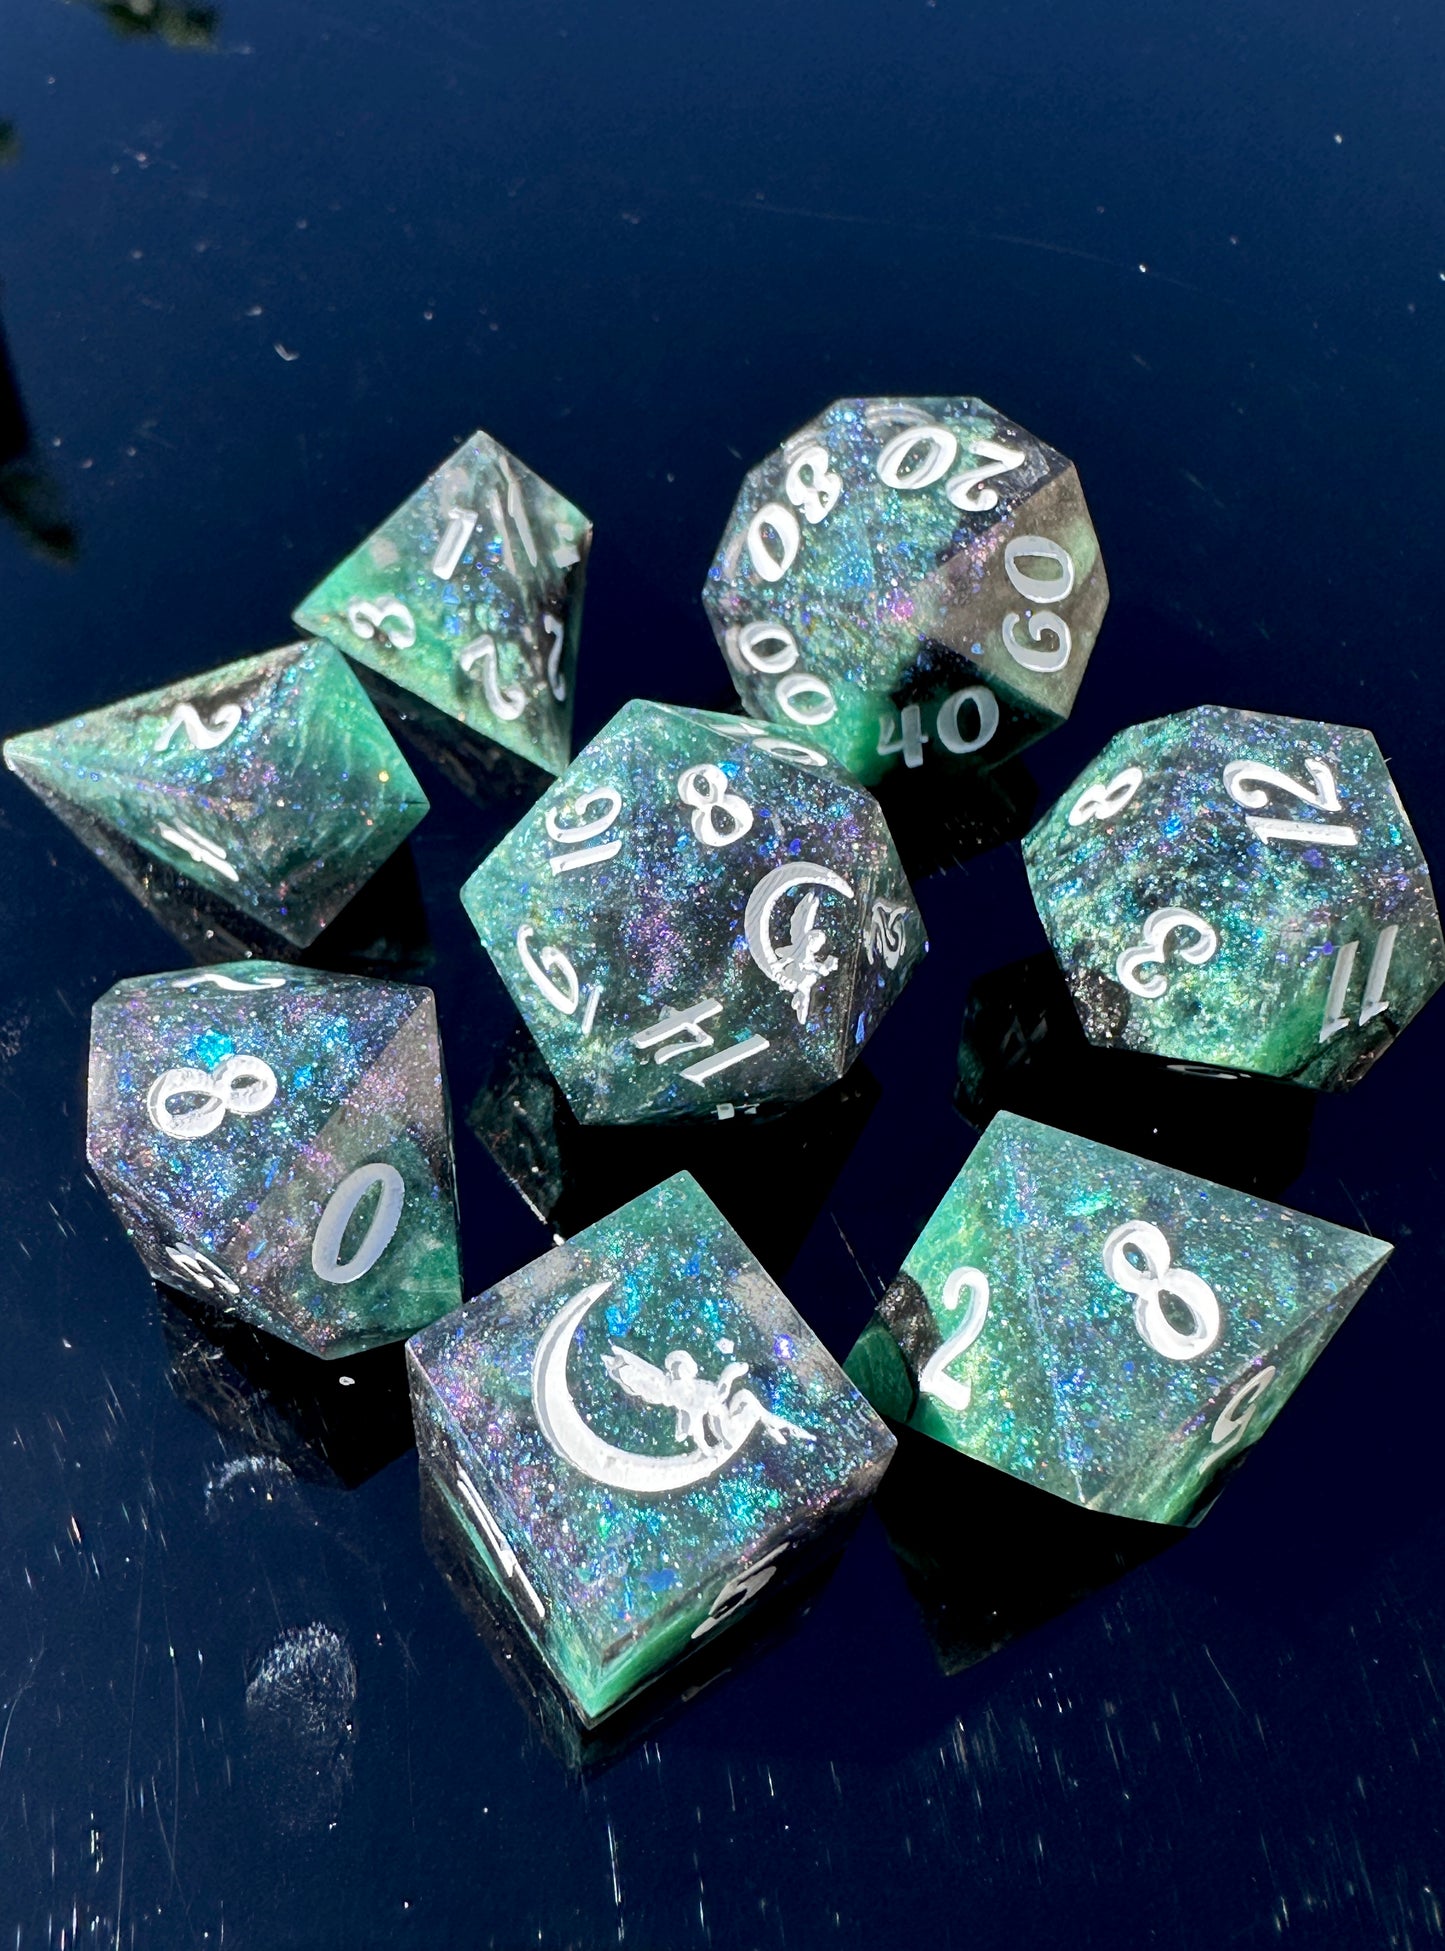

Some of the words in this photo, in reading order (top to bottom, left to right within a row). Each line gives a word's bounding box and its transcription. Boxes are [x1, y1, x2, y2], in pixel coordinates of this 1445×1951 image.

[432, 508, 478, 580] 1
[348, 597, 416, 650] 3
[460, 634, 526, 721] 2
[155, 703, 242, 752] 2
[876, 685, 999, 769] 40
[677, 764, 754, 847] 8
[1068, 767, 1143, 826] 8
[1222, 759, 1359, 846] 12
[1115, 907, 1217, 999] 3
[147, 1054, 277, 1140] 8
[311, 1162, 405, 1284] 0
[1103, 1219, 1220, 1361] 8
[919, 1266, 991, 1411] 2
